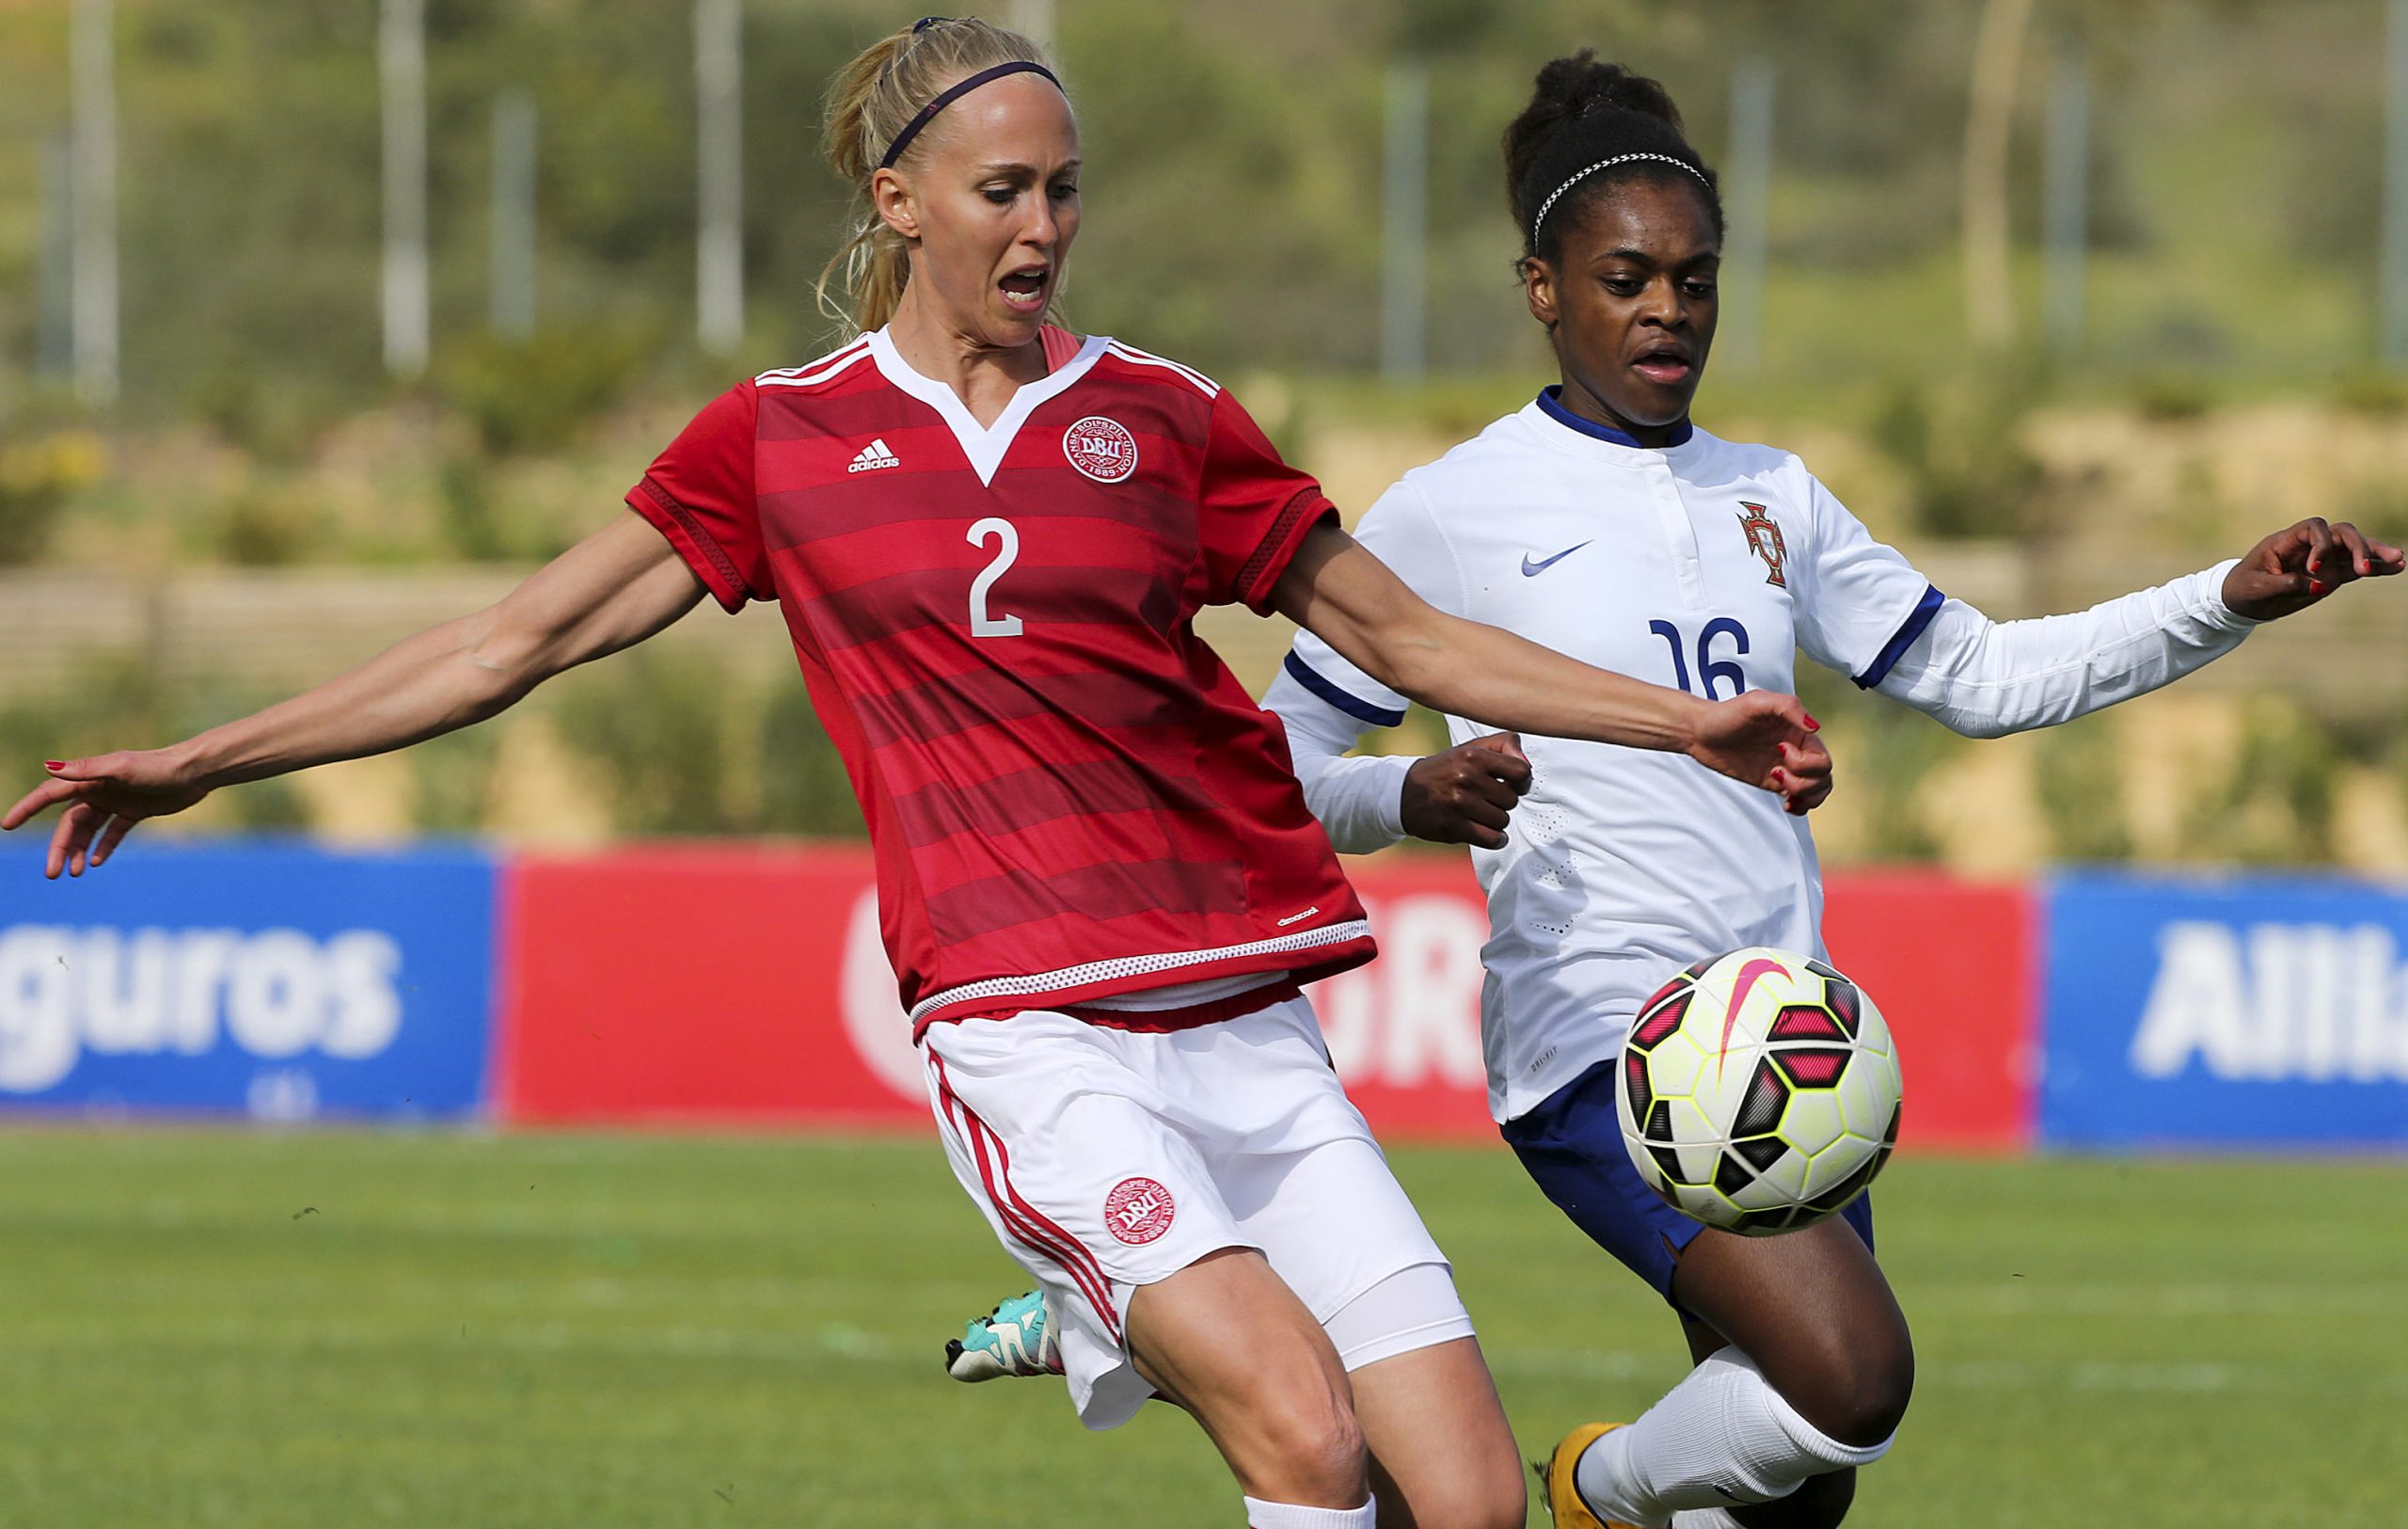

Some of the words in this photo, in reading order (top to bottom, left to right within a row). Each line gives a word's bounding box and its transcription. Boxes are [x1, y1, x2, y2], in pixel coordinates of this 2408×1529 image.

[848, 457, 900, 473] adidas
[1080, 437, 1122, 459] DBU
[1117, 440, 1133, 473] UNION
[1088, 465, 1117, 477] 1889
[966, 517, 1023, 637] 2
[1648, 616, 1750, 703] 16
[0, 924, 403, 1094] guros
[2128, 918, 2408, 1086] Alli
[1116, 1190, 1162, 1230] DBU
